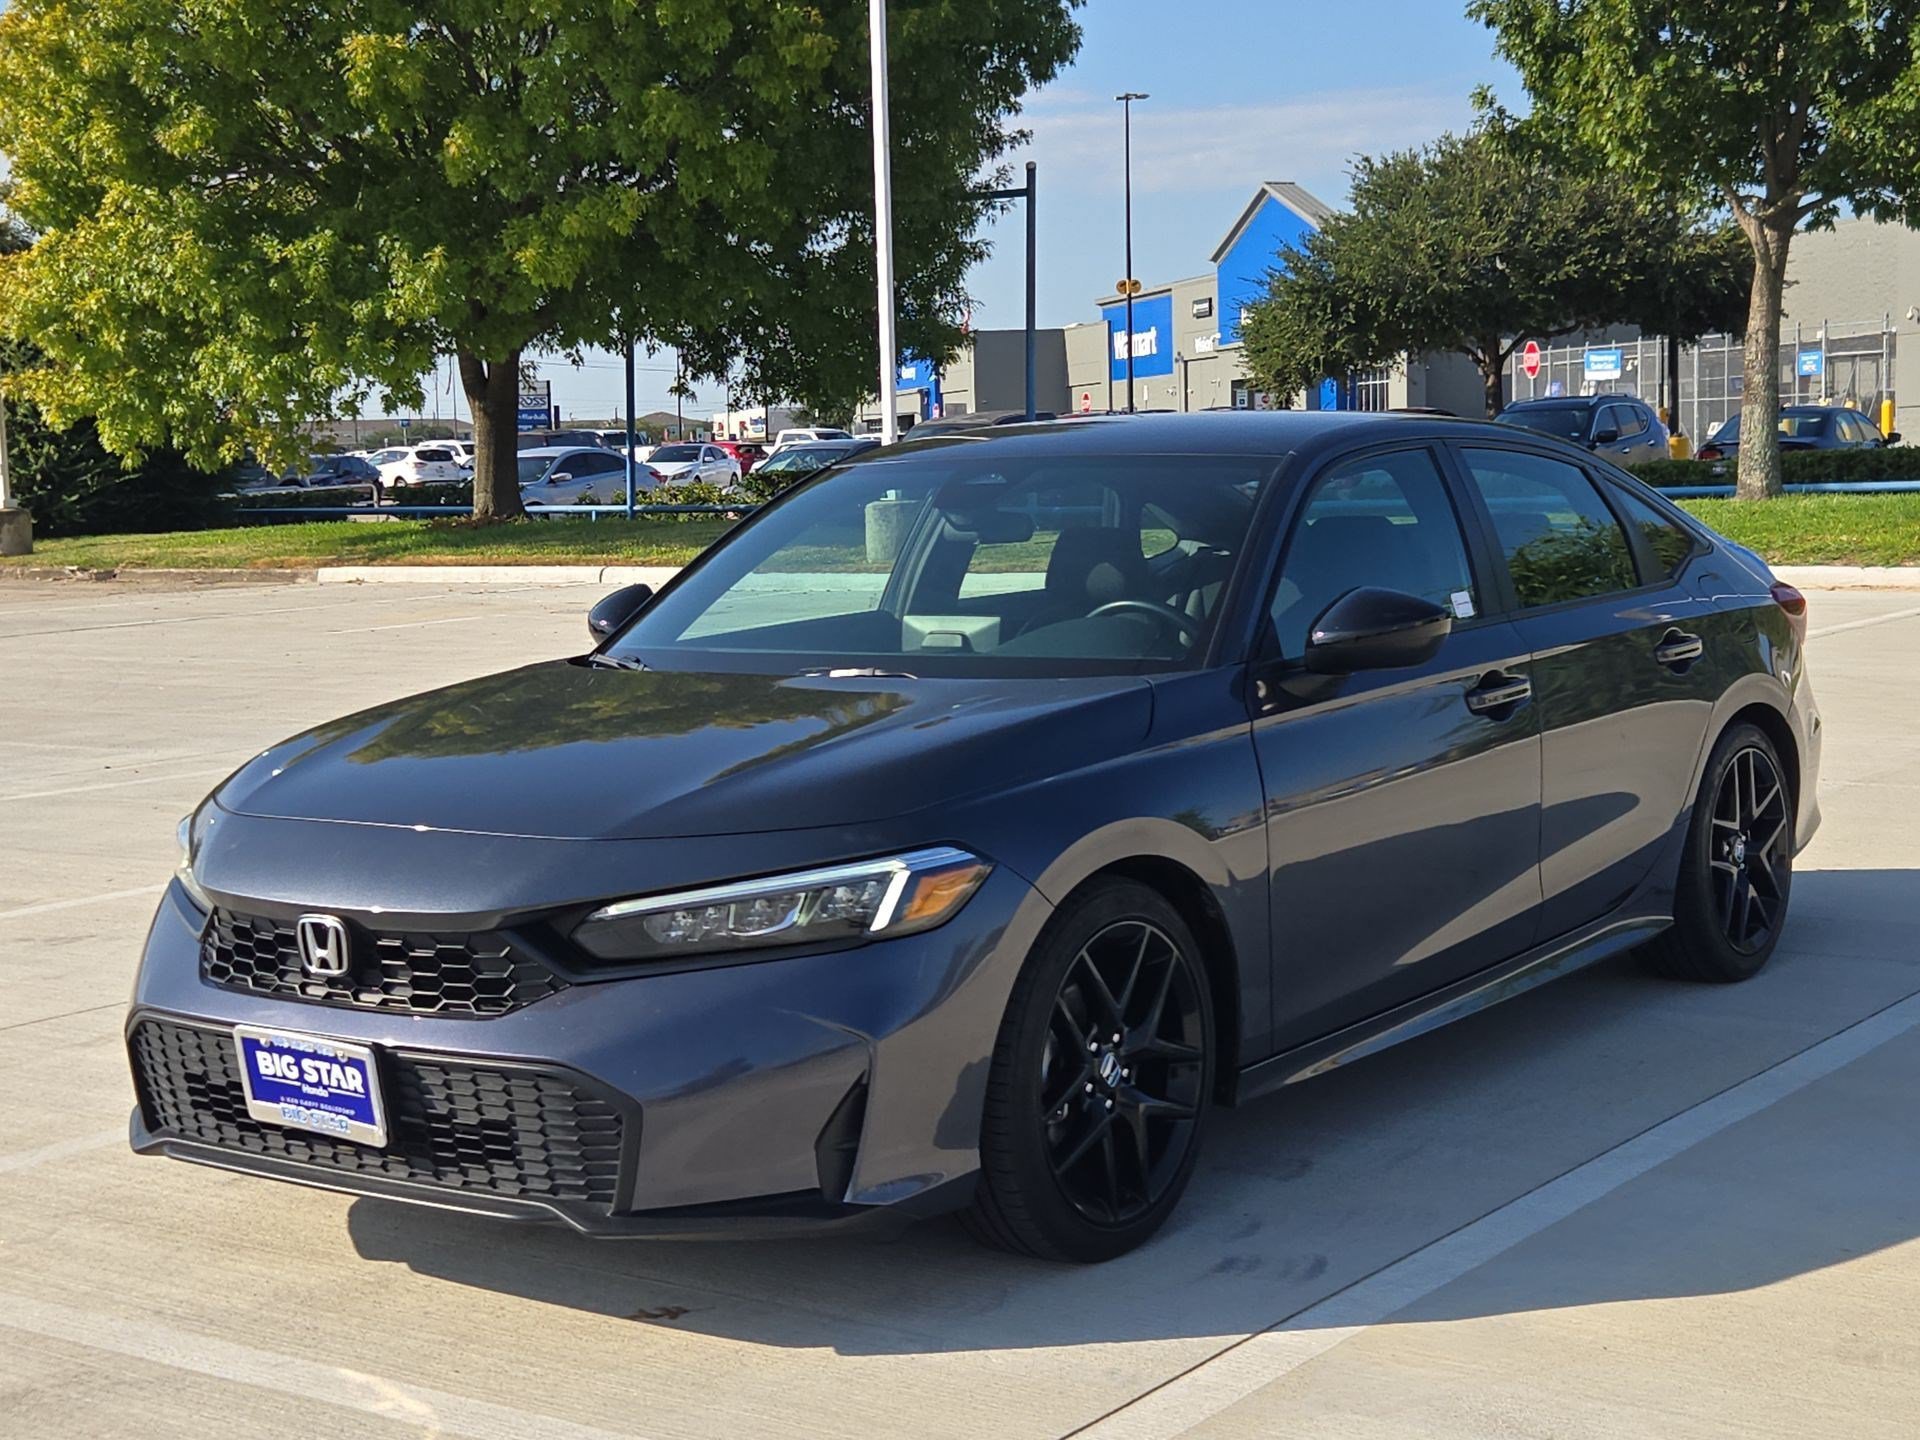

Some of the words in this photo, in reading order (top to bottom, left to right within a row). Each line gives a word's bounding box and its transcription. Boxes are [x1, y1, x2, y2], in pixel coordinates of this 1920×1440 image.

[1113, 326, 1157, 360] Wamart
[255, 1050, 299, 1079] BIG
[301, 1058, 365, 1093] STAR
[302, 1083, 329, 1098] Honda
